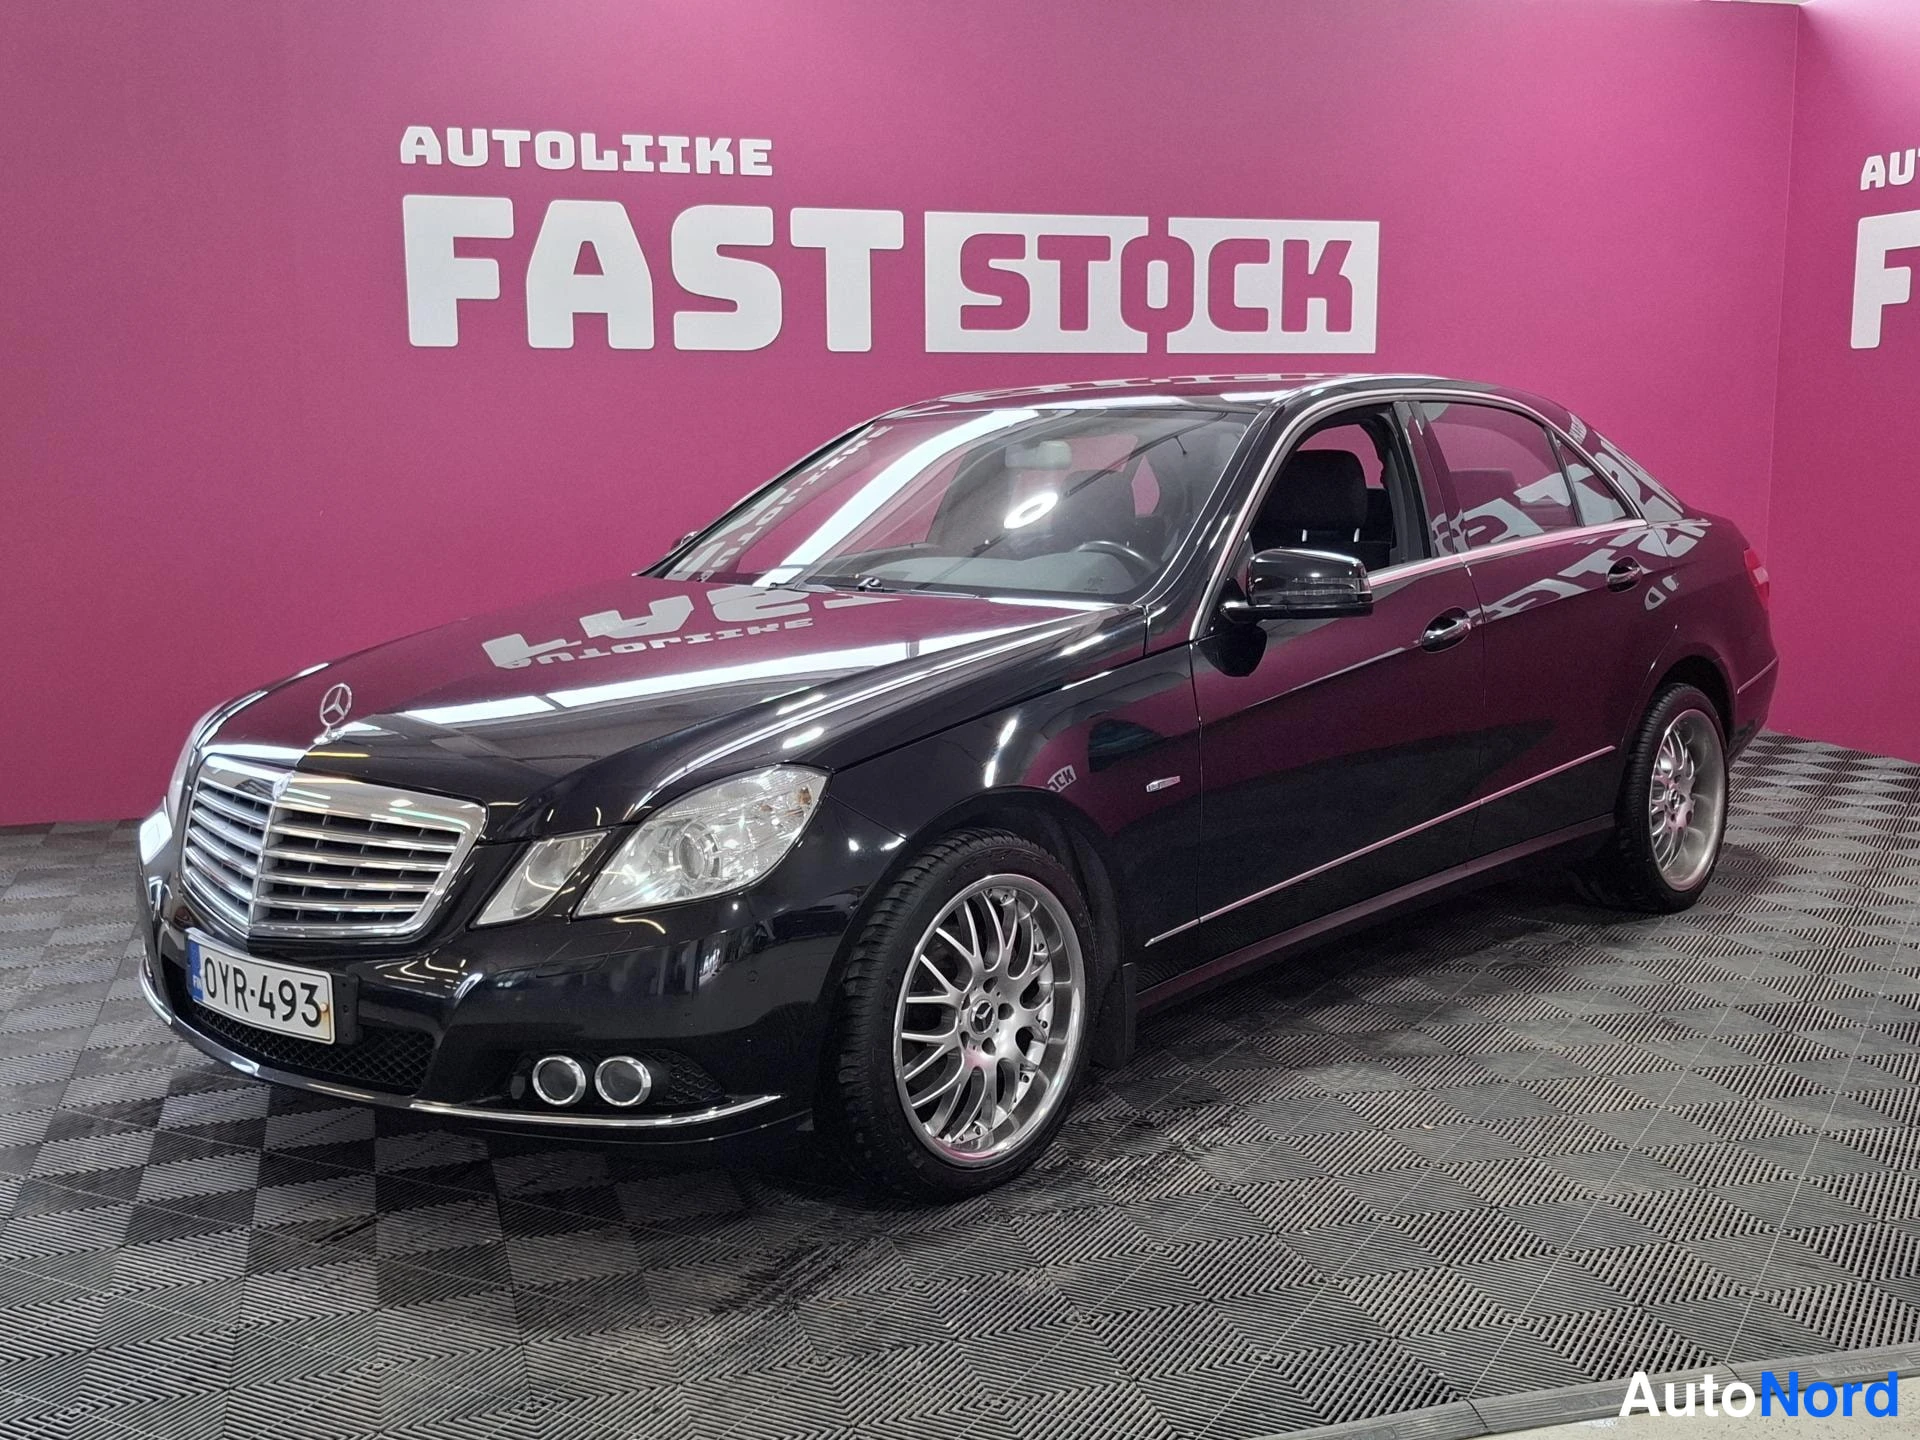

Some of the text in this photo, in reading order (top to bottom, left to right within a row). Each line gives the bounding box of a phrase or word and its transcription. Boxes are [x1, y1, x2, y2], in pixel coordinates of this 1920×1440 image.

[400, 126, 773, 177] AUTOLIIKE
[1860, 148, 1920, 190] AU
[402, 195, 1354, 353] FAST STOCK
[204, 957, 321, 1027] OYR-493
